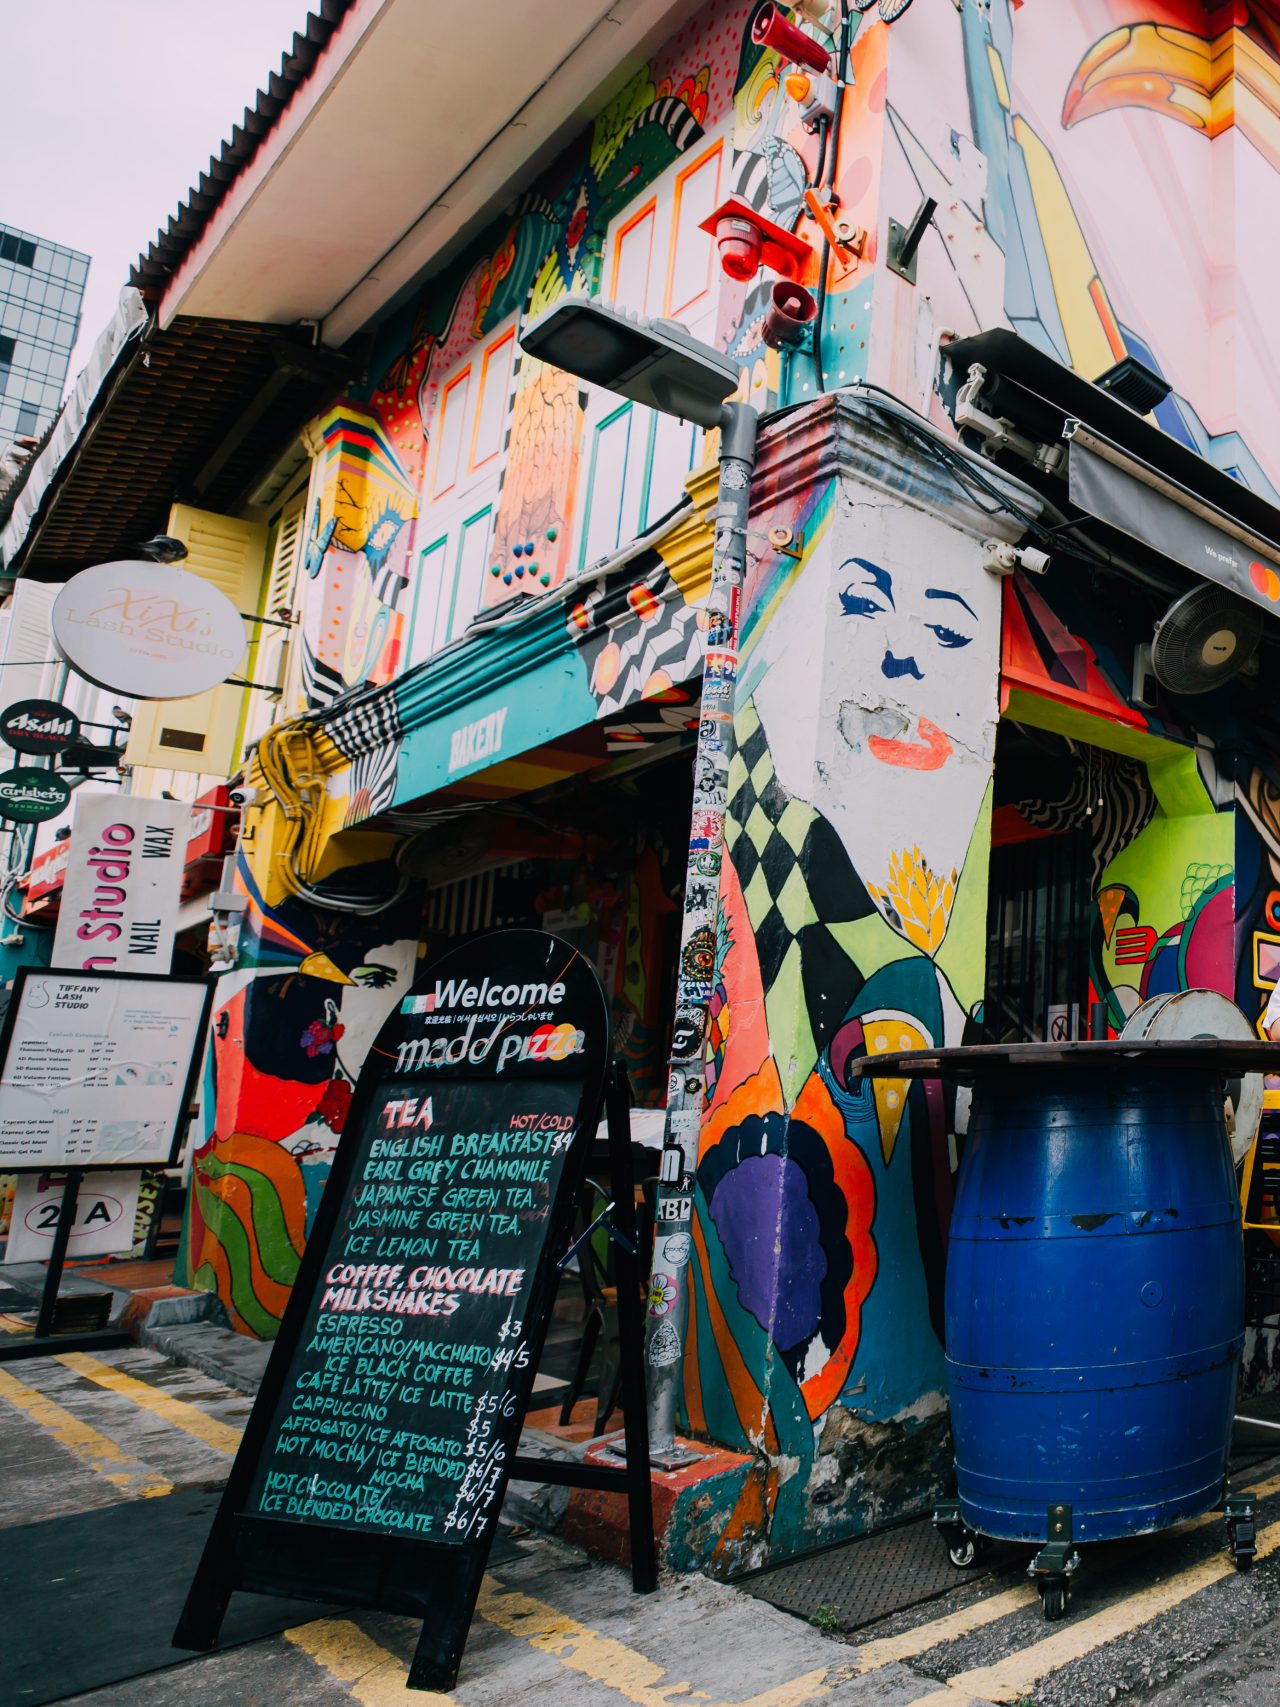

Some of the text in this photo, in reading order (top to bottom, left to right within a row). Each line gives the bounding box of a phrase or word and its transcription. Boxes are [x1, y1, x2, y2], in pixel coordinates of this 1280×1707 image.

[64, 607, 135, 637] Lash
[144, 628, 235, 660] Studio
[6, 713, 74, 736] Asahi
[447, 706, 509, 774] BAKERY
[0, 782, 67, 804] Carlsberg
[8, 803, 51, 811] DENMARK
[141, 825, 175, 858] WAX
[76, 822, 136, 943] Studio
[128, 919, 162, 955] NAIL
[56, 993, 83, 1001] LASH
[58, 984, 101, 993] TIFFANY
[435, 977, 567, 1009] Welcome
[54, 1001, 89, 1010] STUDIO
[395, 1015, 586, 1074] madd pizza
[381, 1096, 434, 1132] TEA
[509, 1112, 574, 1133] HOT/COLD
[369, 1135, 445, 1159] ENGLISH
[449, 1130, 553, 1157] BREAKFAST
[363, 1160, 405, 1181] EARL
[355, 1185, 440, 1207] JAPANESE
[442, 1187, 502, 1210] GREEN
[349, 1209, 424, 1230] JASMINE
[427, 1211, 486, 1233] GREEN
[344, 1235, 481, 1261] ICE LEMON TEA
[408, 1265, 526, 1297] CHOCOLATE
[319, 1286, 460, 1316] MILKSHAKES
[316, 1314, 522, 1342] ESPRESSO $3
[325, 1356, 474, 1388] ICE BLACK COFFEE
[296, 1371, 339, 1393] CAFE
[399, 1385, 425, 1404] ICE
[429, 1389, 476, 1415] LATTE
[474, 1390, 518, 1420] $5/6
[292, 1394, 492, 1440] CAPPUCCINO $5
[275, 1434, 309, 1454] HOT
[376, 1449, 403, 1467] ICE
[404, 1452, 467, 1481] BLENDED
[366, 1426, 392, 1444] ICE
[390, 1430, 463, 1457] AFFOGATO
[462, 1438, 507, 1461] $5/6
[264, 1471, 296, 1492] HOT
[369, 1468, 495, 1508] MOCHA $6/7
[258, 1492, 283, 1512] ICE
[286, 1496, 353, 1521] BLENDED
[355, 1504, 434, 1533] CHOCOLATE
[444, 1506, 489, 1539] $6/7
